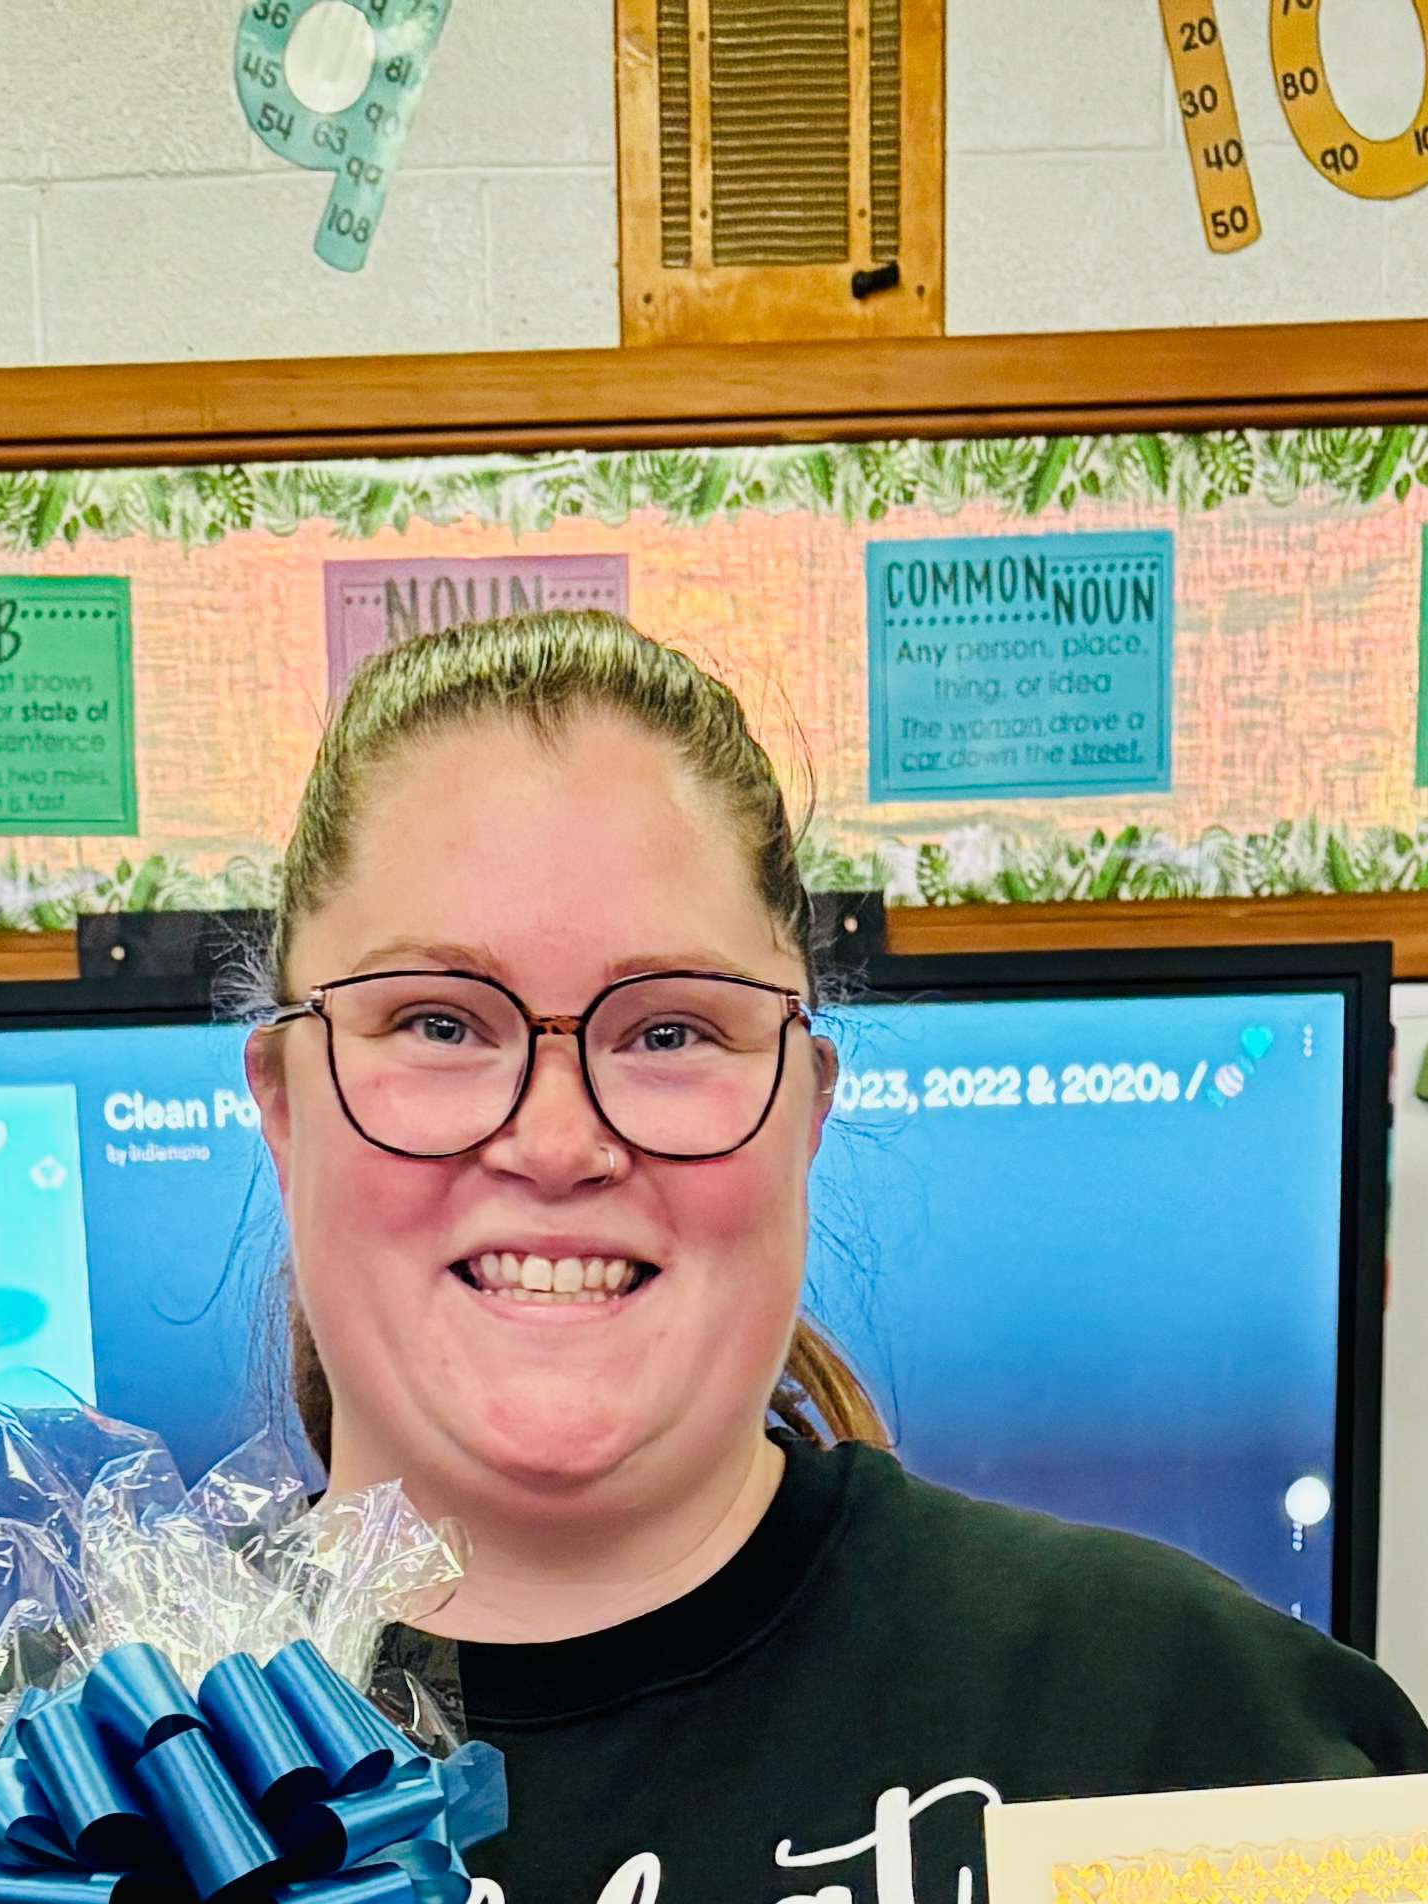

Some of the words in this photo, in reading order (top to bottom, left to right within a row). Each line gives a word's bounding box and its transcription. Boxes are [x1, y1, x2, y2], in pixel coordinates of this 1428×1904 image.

[1179, 17, 1218, 51] 20
[243, 53, 280, 88] 45
[385, 56, 413, 85] 81
[1282, 66, 1318, 101] 80
[1182, 84, 1218, 119] 30
[257, 103, 294, 141] 54
[313, 121, 348, 156] 63
[1203, 140, 1243, 172] 40
[1321, 144, 1358, 175] 90
[328, 205, 371, 243] 108
[1210, 205, 1249, 239] 50
[887, 554, 1046, 609] COMMON
[1052, 575, 1155, 626] NOUN
[895, 639, 947, 667] Any
[1049, 671, 1112, 695] idea
[21, 702, 78, 723] state
[833, 1068, 919, 1116] 023,
[922, 1065, 1021, 1109] 2022
[1026, 1064, 1058, 1105] &
[1060, 1061, 1180, 1105] 2020s
[103, 1090, 209, 1133] Clean
[212, 1087, 263, 1130] Po
